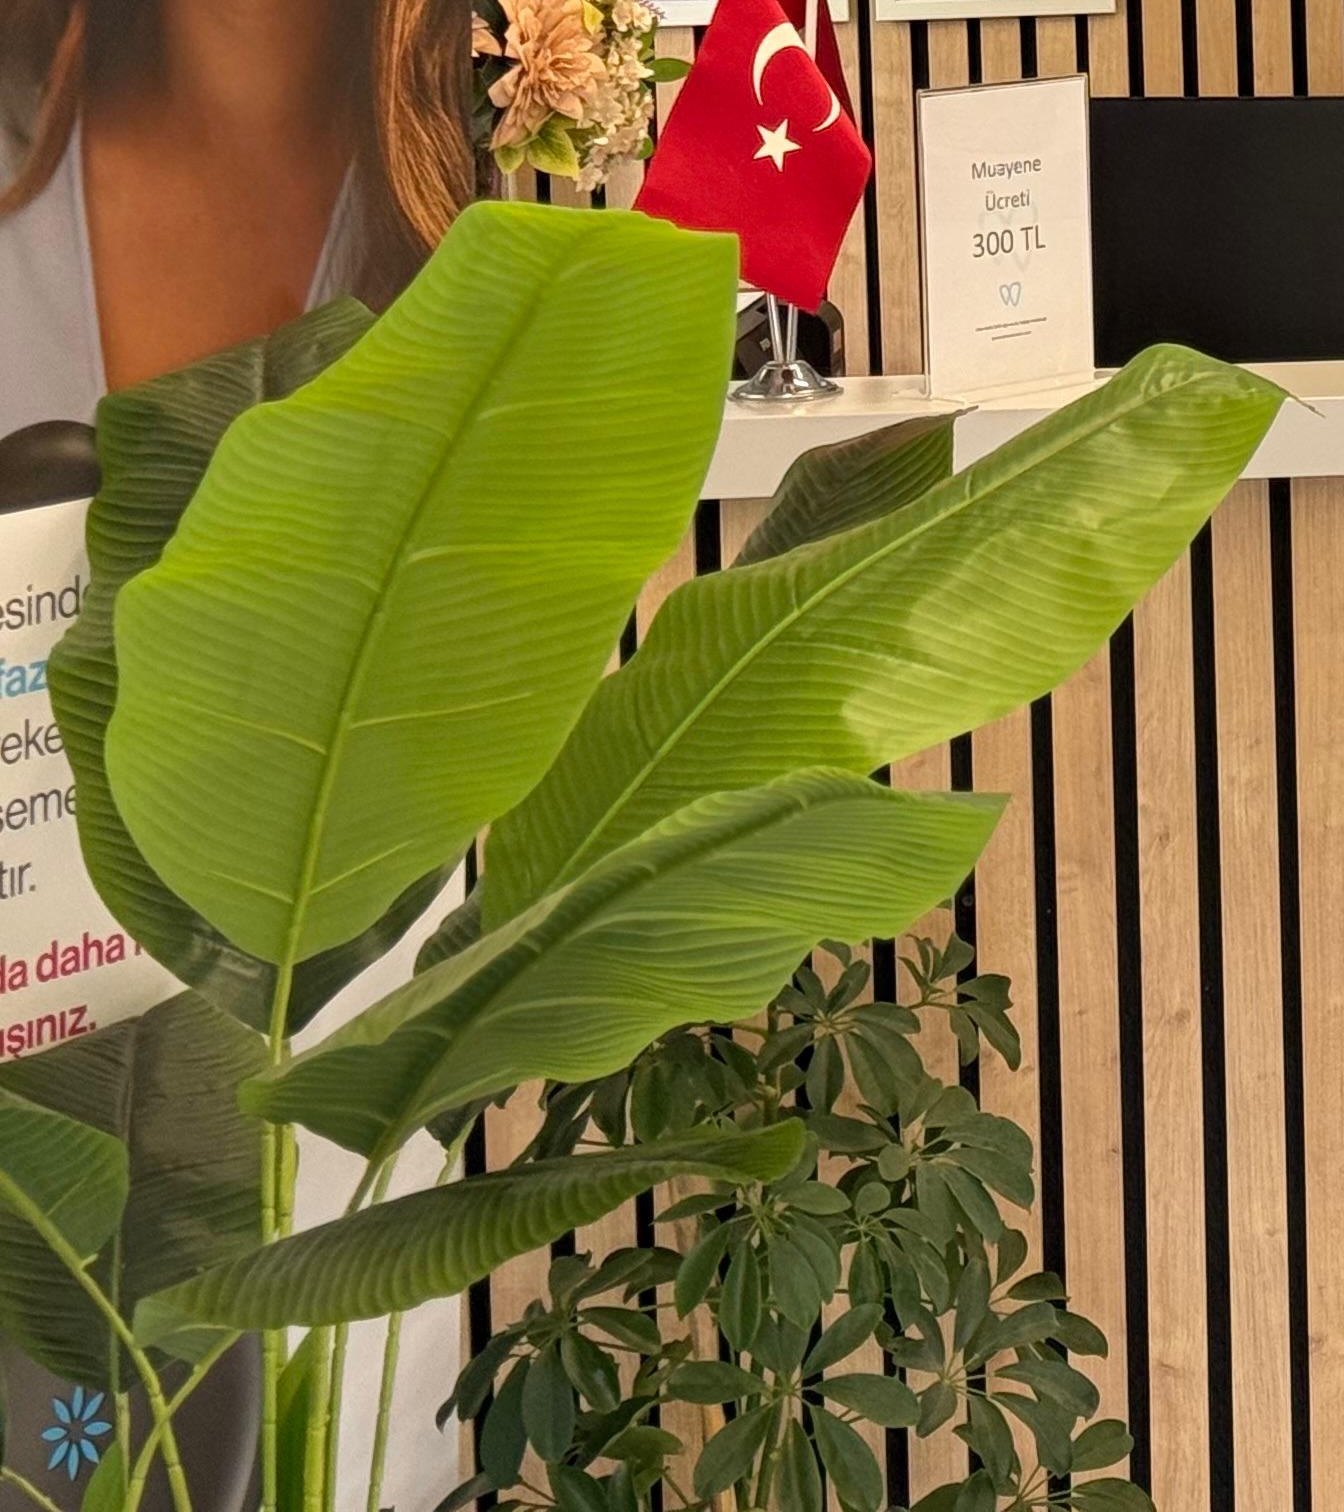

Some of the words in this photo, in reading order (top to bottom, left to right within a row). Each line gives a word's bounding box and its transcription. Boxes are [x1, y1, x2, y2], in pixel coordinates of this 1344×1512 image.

[971, 157, 1042, 180] Muayene
[985, 189, 1031, 212] Ücreti
[972, 229, 1014, 258] 300
[1020, 225, 1046, 251] TL
[0, 954, 28, 994] a
[36, 931, 125, 983] daha
